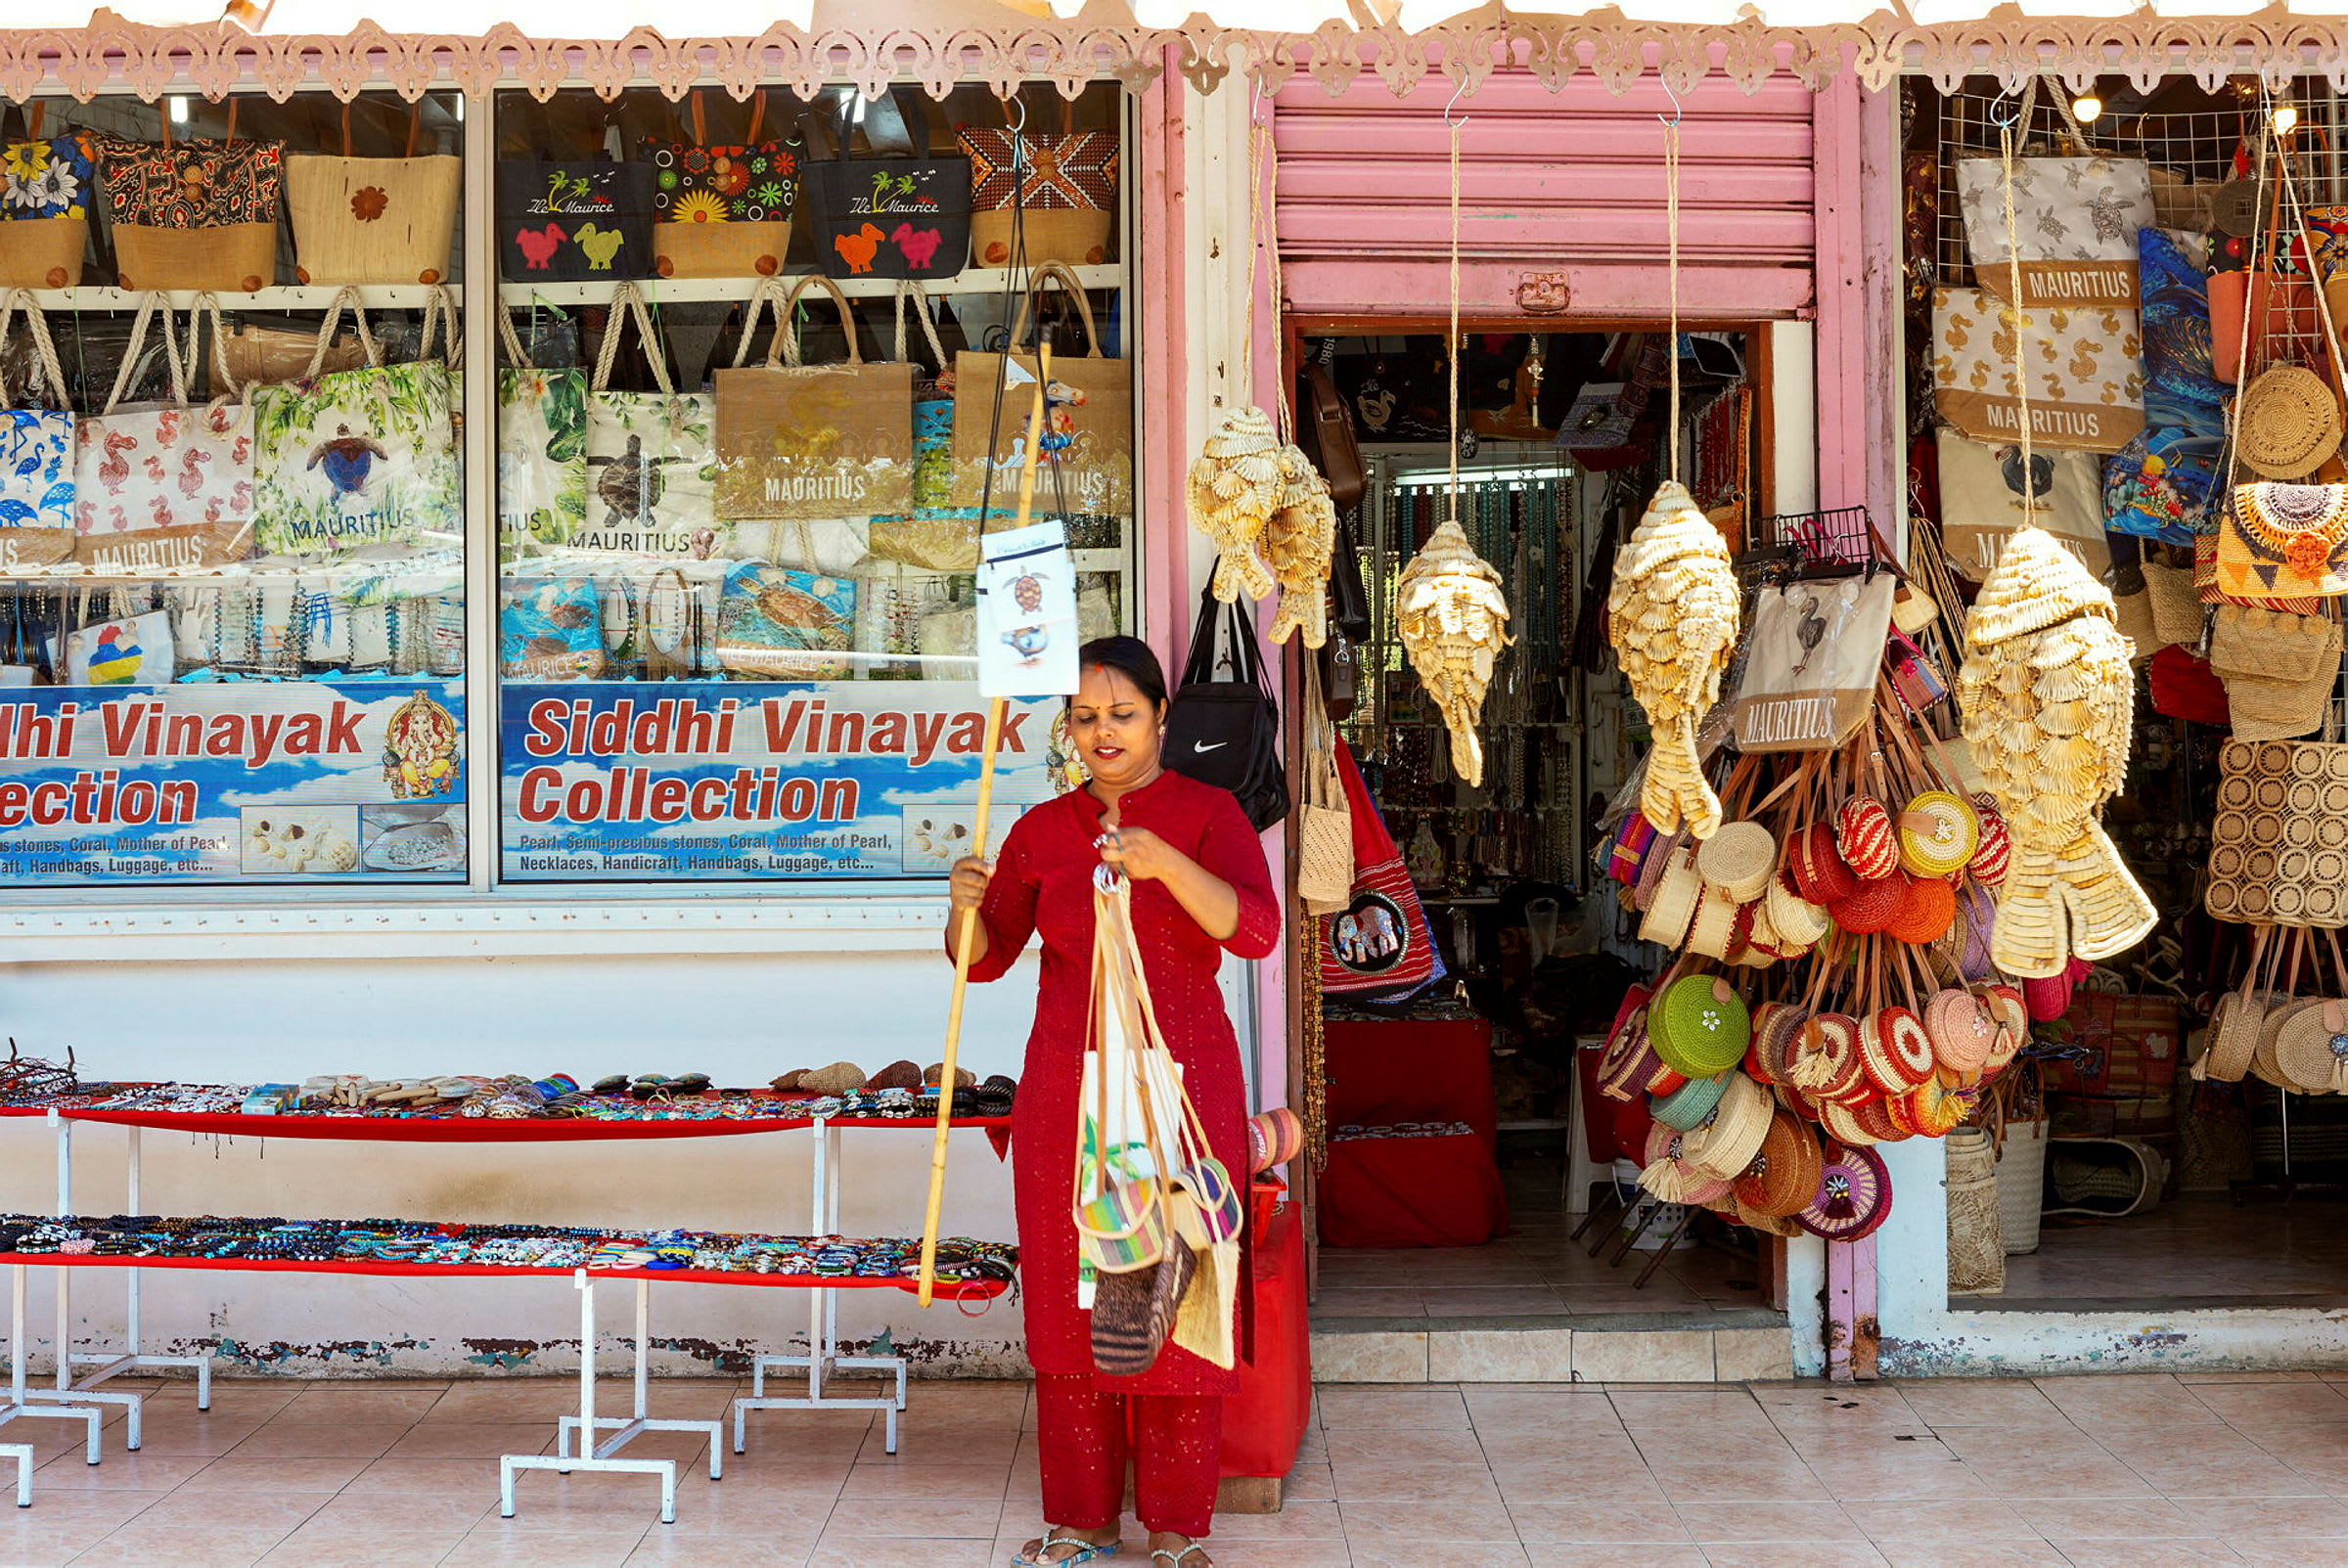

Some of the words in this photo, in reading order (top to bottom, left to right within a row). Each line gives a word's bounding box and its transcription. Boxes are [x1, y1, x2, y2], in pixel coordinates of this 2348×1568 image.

[558, 201, 615, 213] Maurice
[881, 199, 939, 213] Maurice
[2028, 271, 2131, 298] MAURITIUS
[765, 474, 867, 502] MAURITIUS
[292, 508, 415, 541] MAURITIUS
[93, 535, 203, 571] MAURITIUS
[566, 532, 690, 553] MAURITIUS
[100, 699, 368, 768] Vinayak
[524, 698, 742, 757] Siddhi
[760, 697, 1031, 767] Vinayak
[1742, 696, 1836, 744] MAURITIUS
[519, 765, 861, 824] Collection
[15, 838, 65, 854] stones,
[70, 837, 112, 853] Coral,
[116, 837, 166, 851] Mother
[171, 836, 185, 850] of
[520, 835, 562, 851] Pearl,
[567, 834, 668, 851] Semi-precious
[674, 834, 724, 850] stones,
[729, 834, 771, 850] Coral,
[777, 834, 827, 849] Mother
[833, 834, 846, 849] of
[851, 834, 892, 850] Pearl,
[30, 858, 104, 875] Handbags,
[109, 858, 172, 874] Luggage,
[177, 857, 213, 871] etc...
[520, 856, 598, 873] Necklaces,
[604, 855, 682, 872] Handicraft,
[688, 855, 763, 873] Handbags,
[768, 854, 832, 873] Luggage,
[837, 855, 874, 870] etc...
